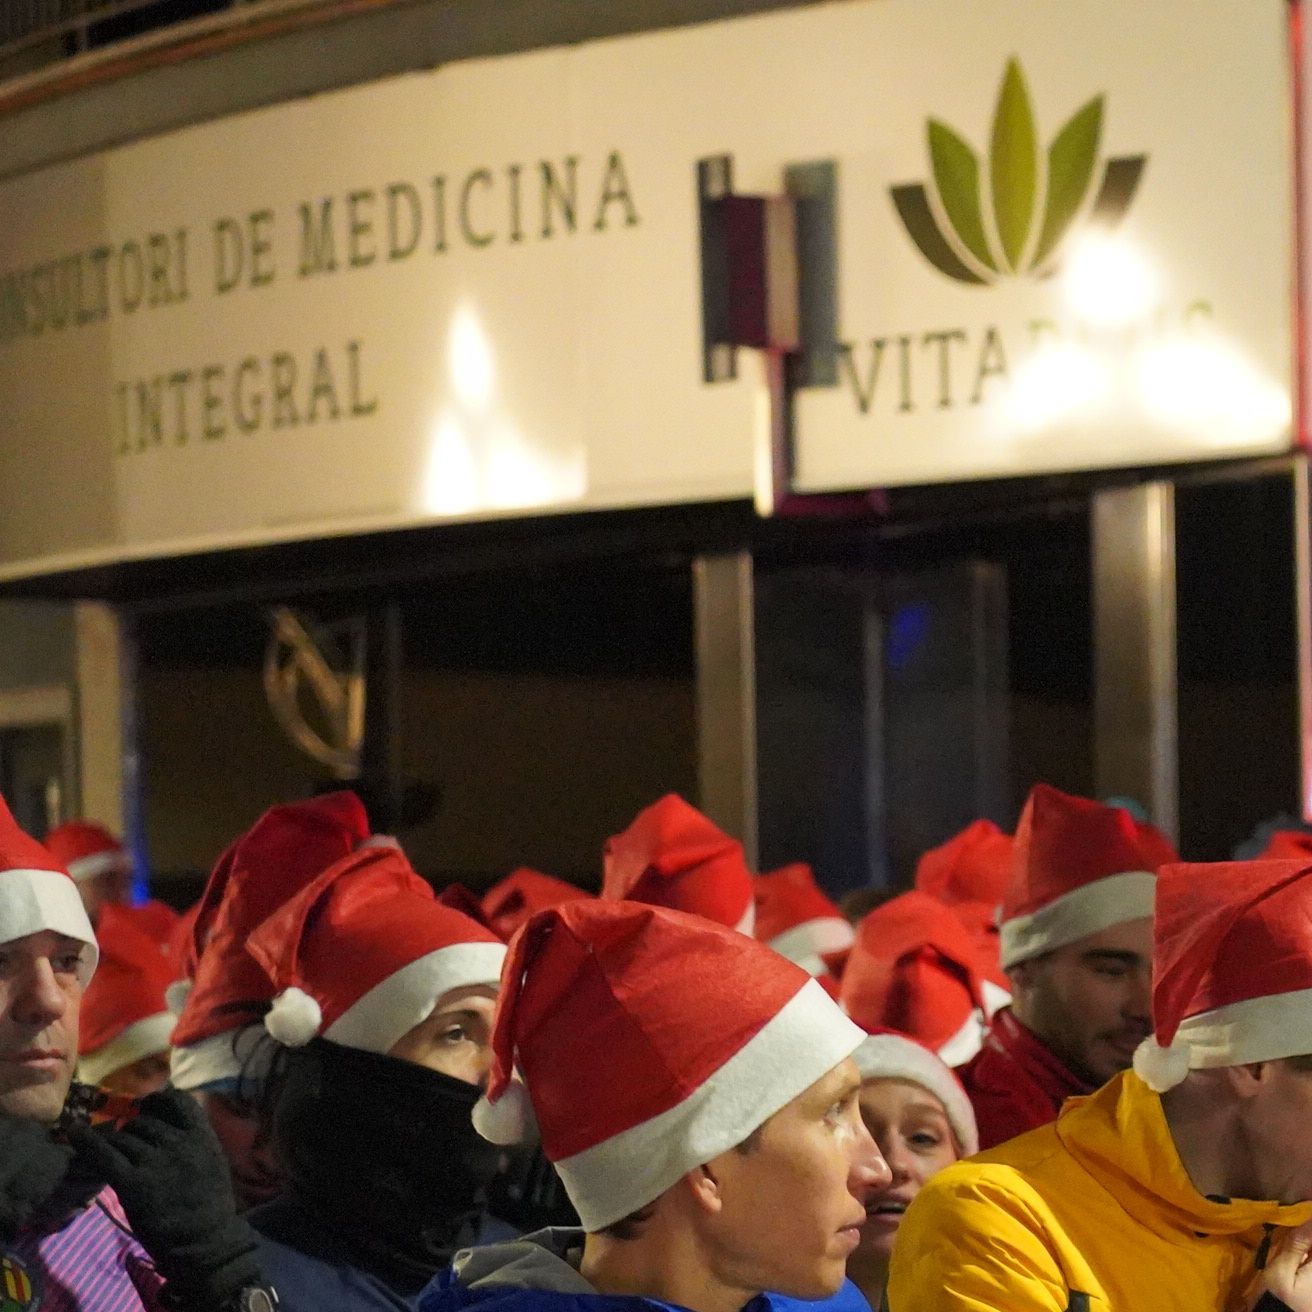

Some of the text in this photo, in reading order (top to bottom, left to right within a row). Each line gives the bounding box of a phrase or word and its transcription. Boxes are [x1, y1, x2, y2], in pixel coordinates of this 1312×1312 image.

[213, 210, 276, 296] DE
[297, 149, 641, 282] MEDICINA
[114, 340, 379, 457] INTEGRAL
[838, 324, 1008, 415] VITA
